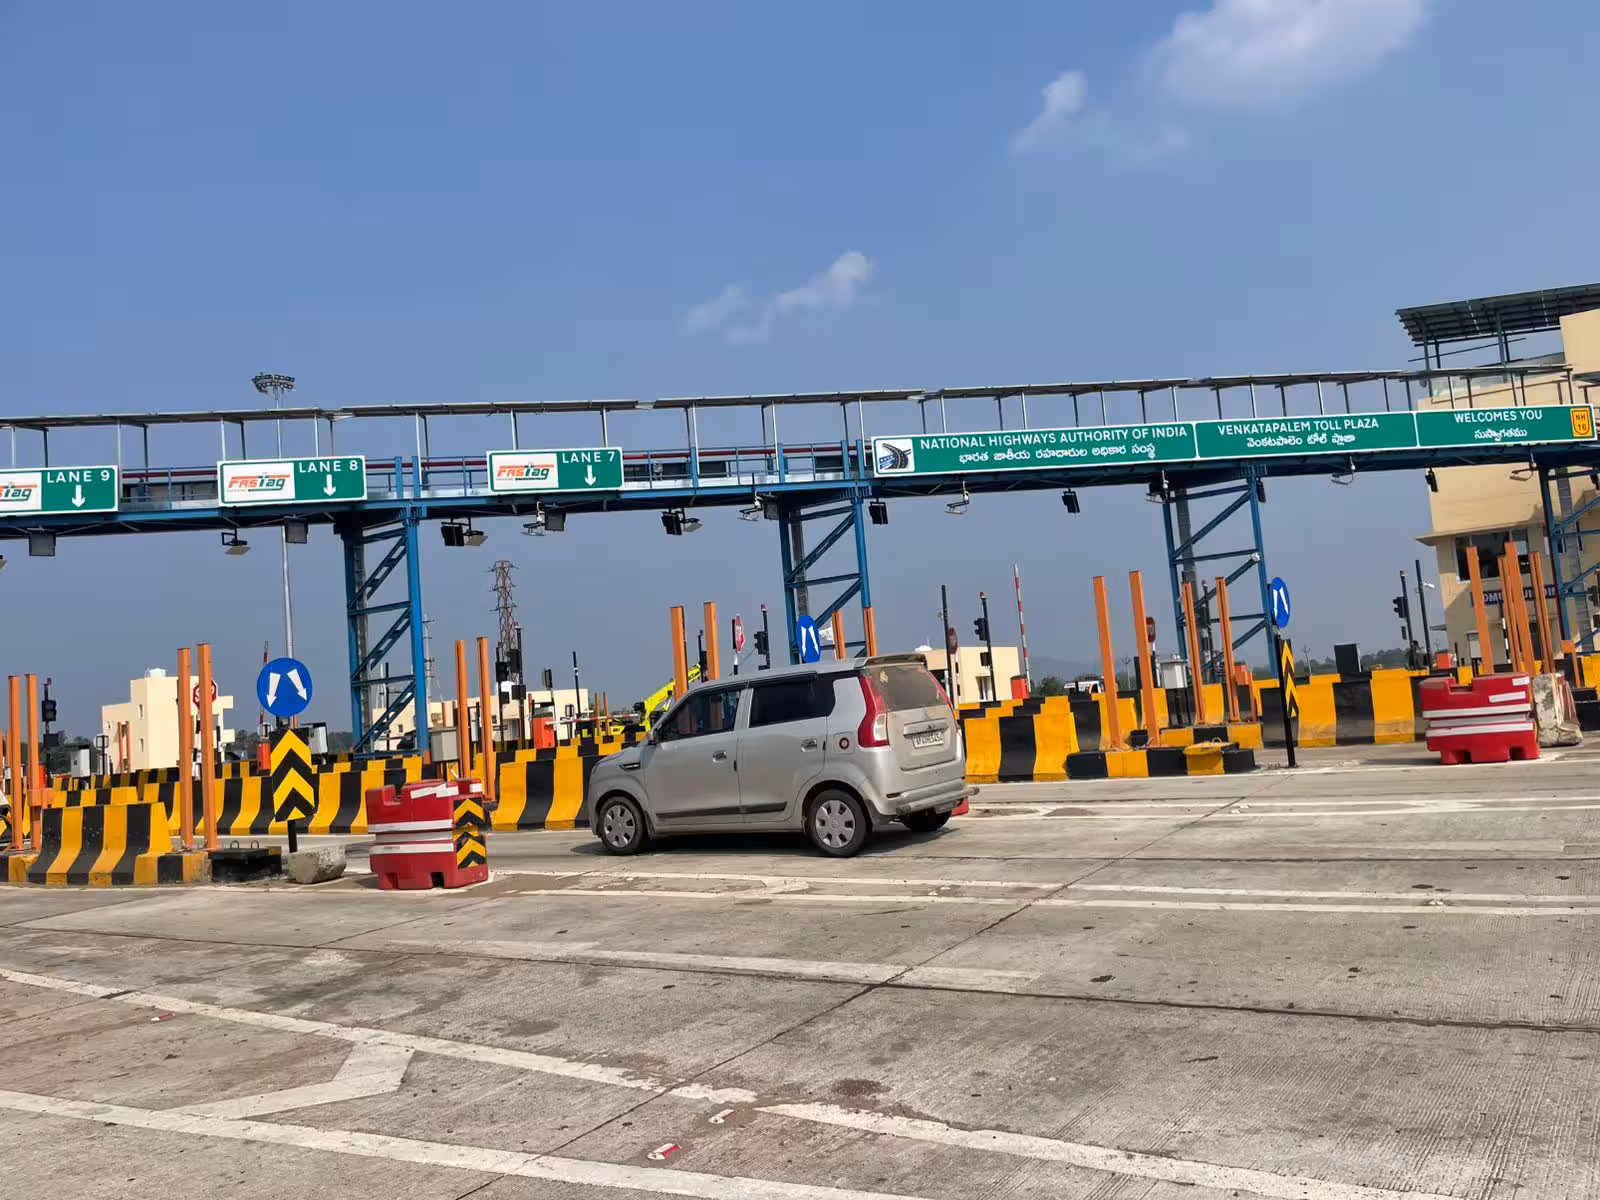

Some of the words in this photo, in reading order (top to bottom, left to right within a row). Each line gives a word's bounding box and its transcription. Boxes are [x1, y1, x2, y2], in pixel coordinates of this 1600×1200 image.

[1454, 411, 1517, 423] WELCOMES
[1519, 410, 1542, 421] YOU
[1575, 413, 1586, 421] NH
[1218, 421, 1311, 435] VENKATAPALEM
[1313, 420, 1341, 431] TOLL
[1344, 418, 1379, 430] PLAZA
[1577, 423, 1587, 431] 16
[920, 437, 986, 450] NATIONAL
[989, 432, 1057, 446] HIGHWAYS
[1060, 430, 1129, 443] AUTHORITY
[1132, 428, 1149, 440] OF
[1152, 426, 1188, 438] INDIA
[562, 452, 601, 463] LANE
[607, 451, 615, 462] 7
[299, 461, 341, 473] LANE
[349, 460, 358, 471] 8
[47, 471, 92, 483] LANE
[101, 469, 110, 482] 9
